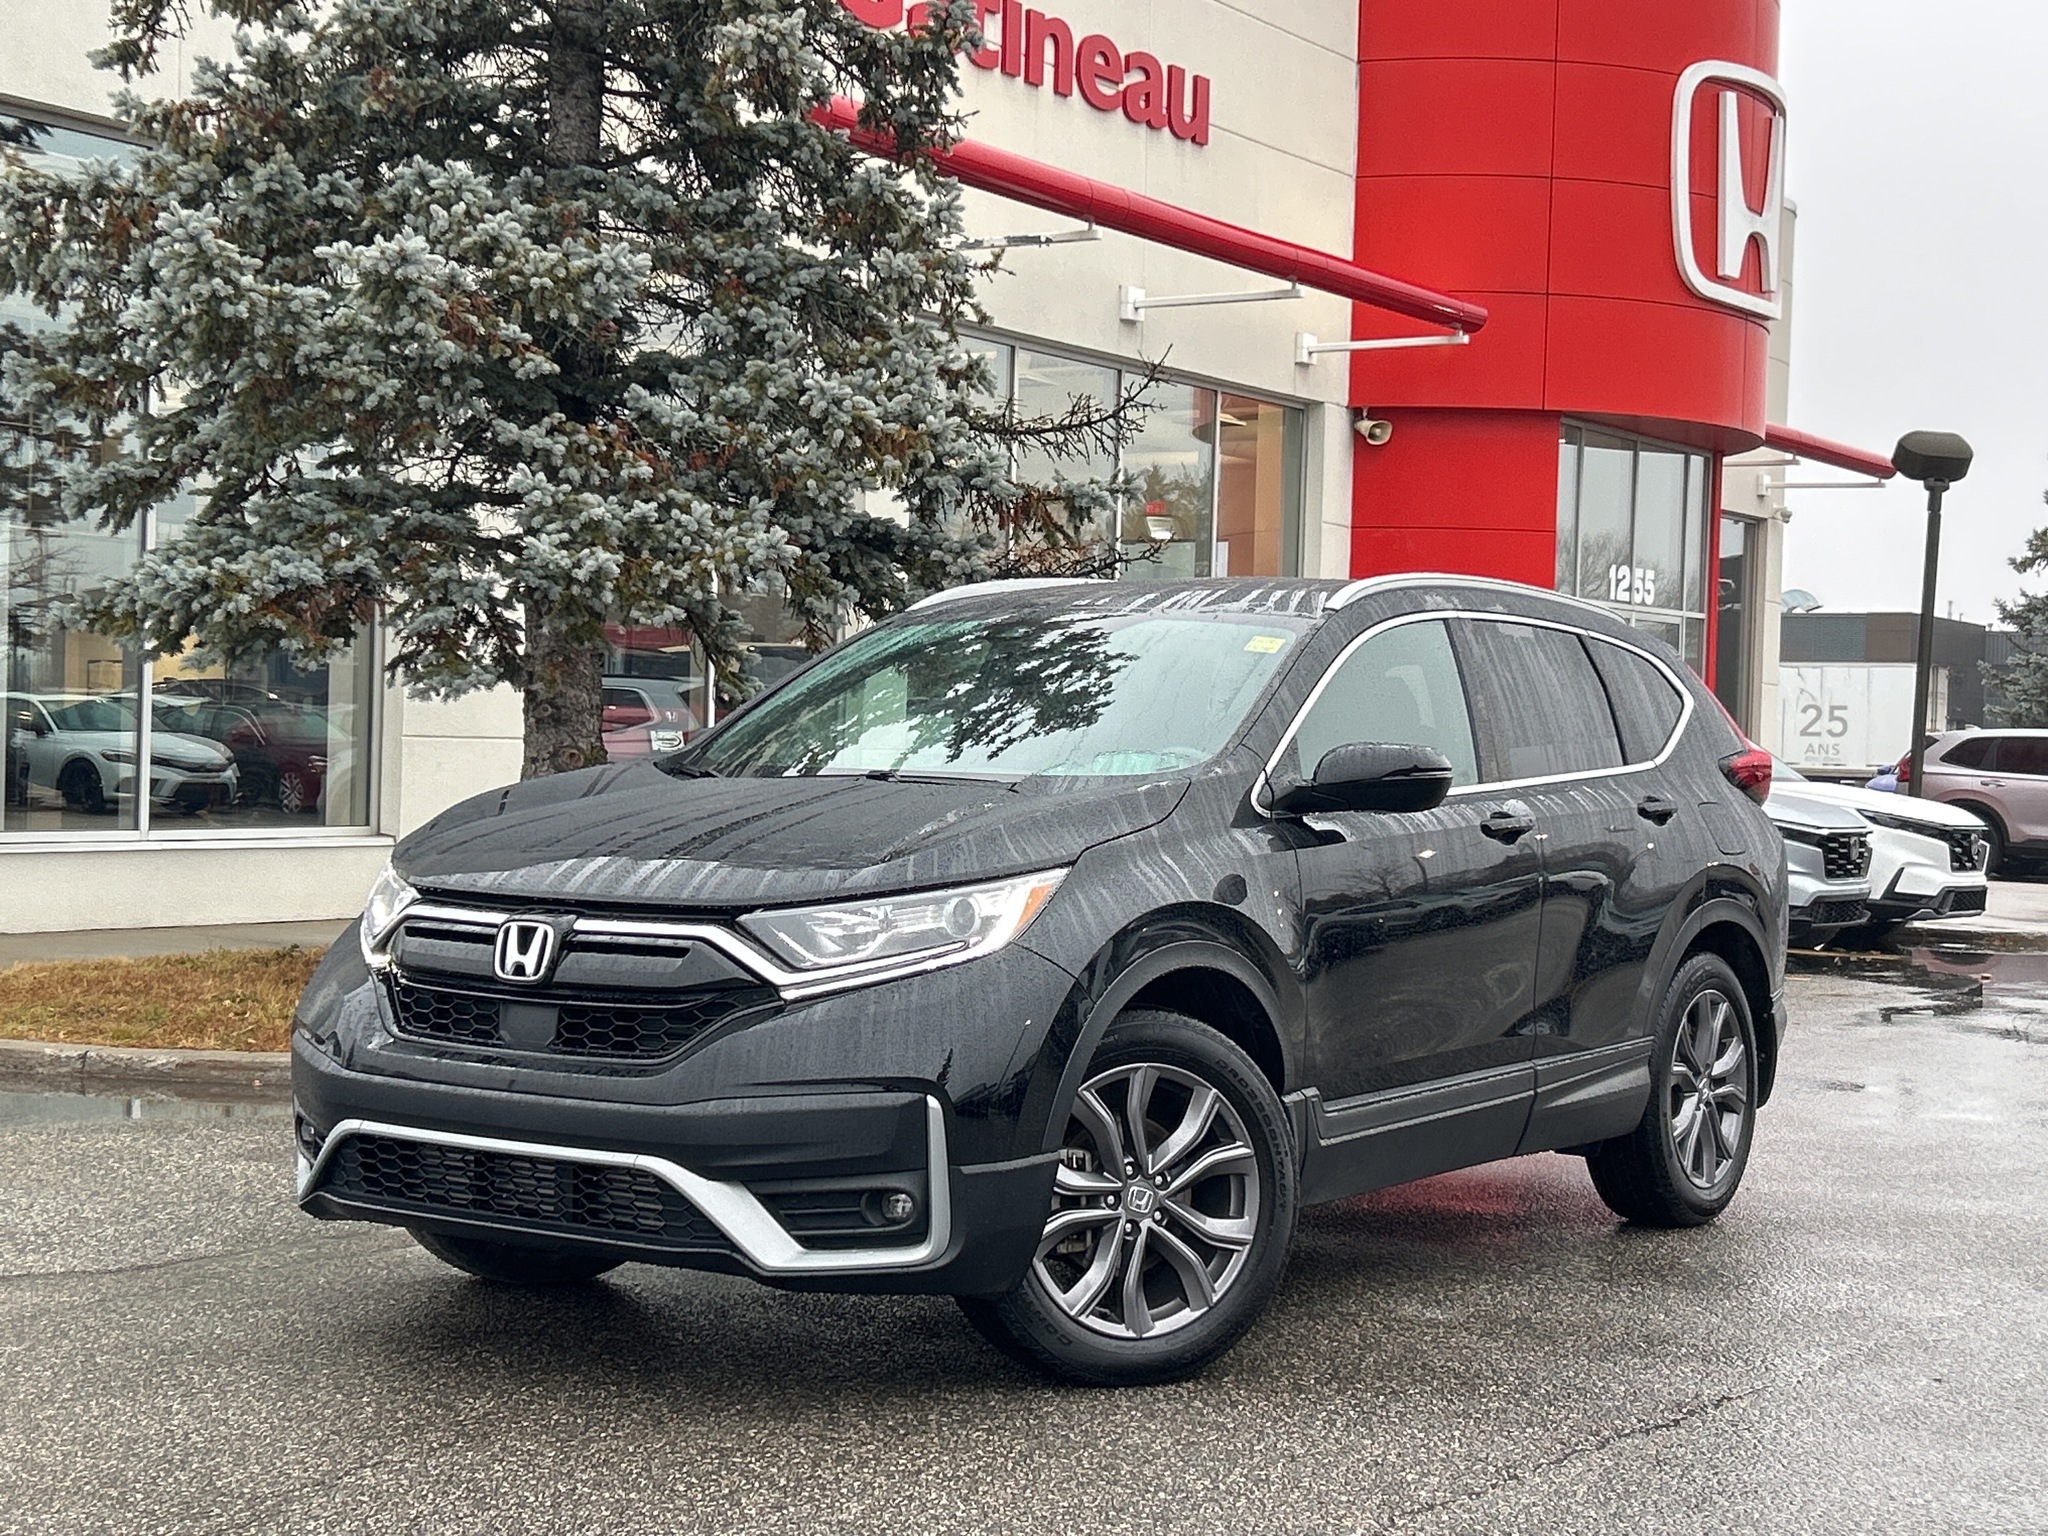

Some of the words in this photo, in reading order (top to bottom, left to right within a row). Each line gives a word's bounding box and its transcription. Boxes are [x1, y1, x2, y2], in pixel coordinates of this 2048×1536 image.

[839, 0, 1210, 146] tineau
[1609, 564, 1655, 605] 1255
[1800, 704, 1848, 738] 25
[1805, 743, 1841, 756] ANS
